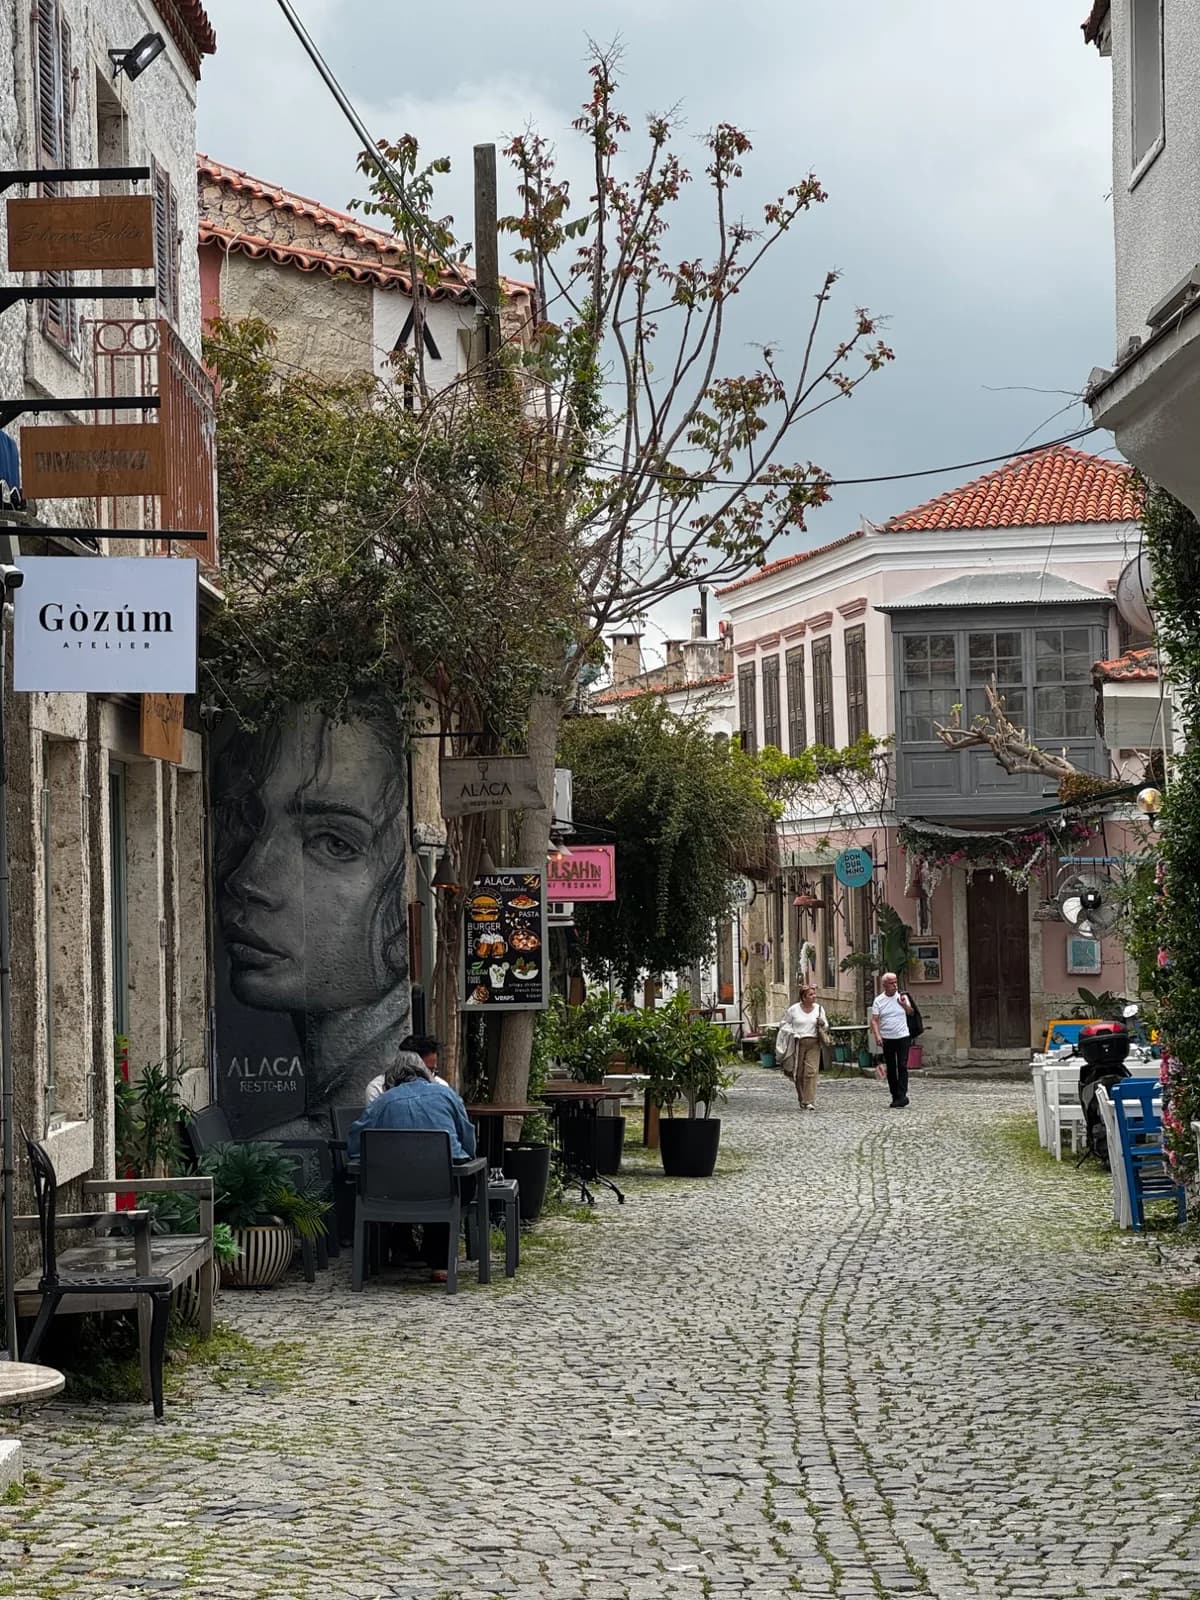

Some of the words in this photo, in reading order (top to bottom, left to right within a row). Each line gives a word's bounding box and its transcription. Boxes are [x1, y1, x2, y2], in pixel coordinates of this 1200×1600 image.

[39, 603, 173, 633] Gòzúm
[63, 641, 152, 650] ATELIER
[460, 782, 512, 798] ALACA
[484, 876, 516, 886] ALACA
[518, 910, 540, 918] PASTA
[467, 922, 501, 931] BURGER
[466, 968, 488, 976] VEGAN
[227, 1055, 305, 1077] ALACA
